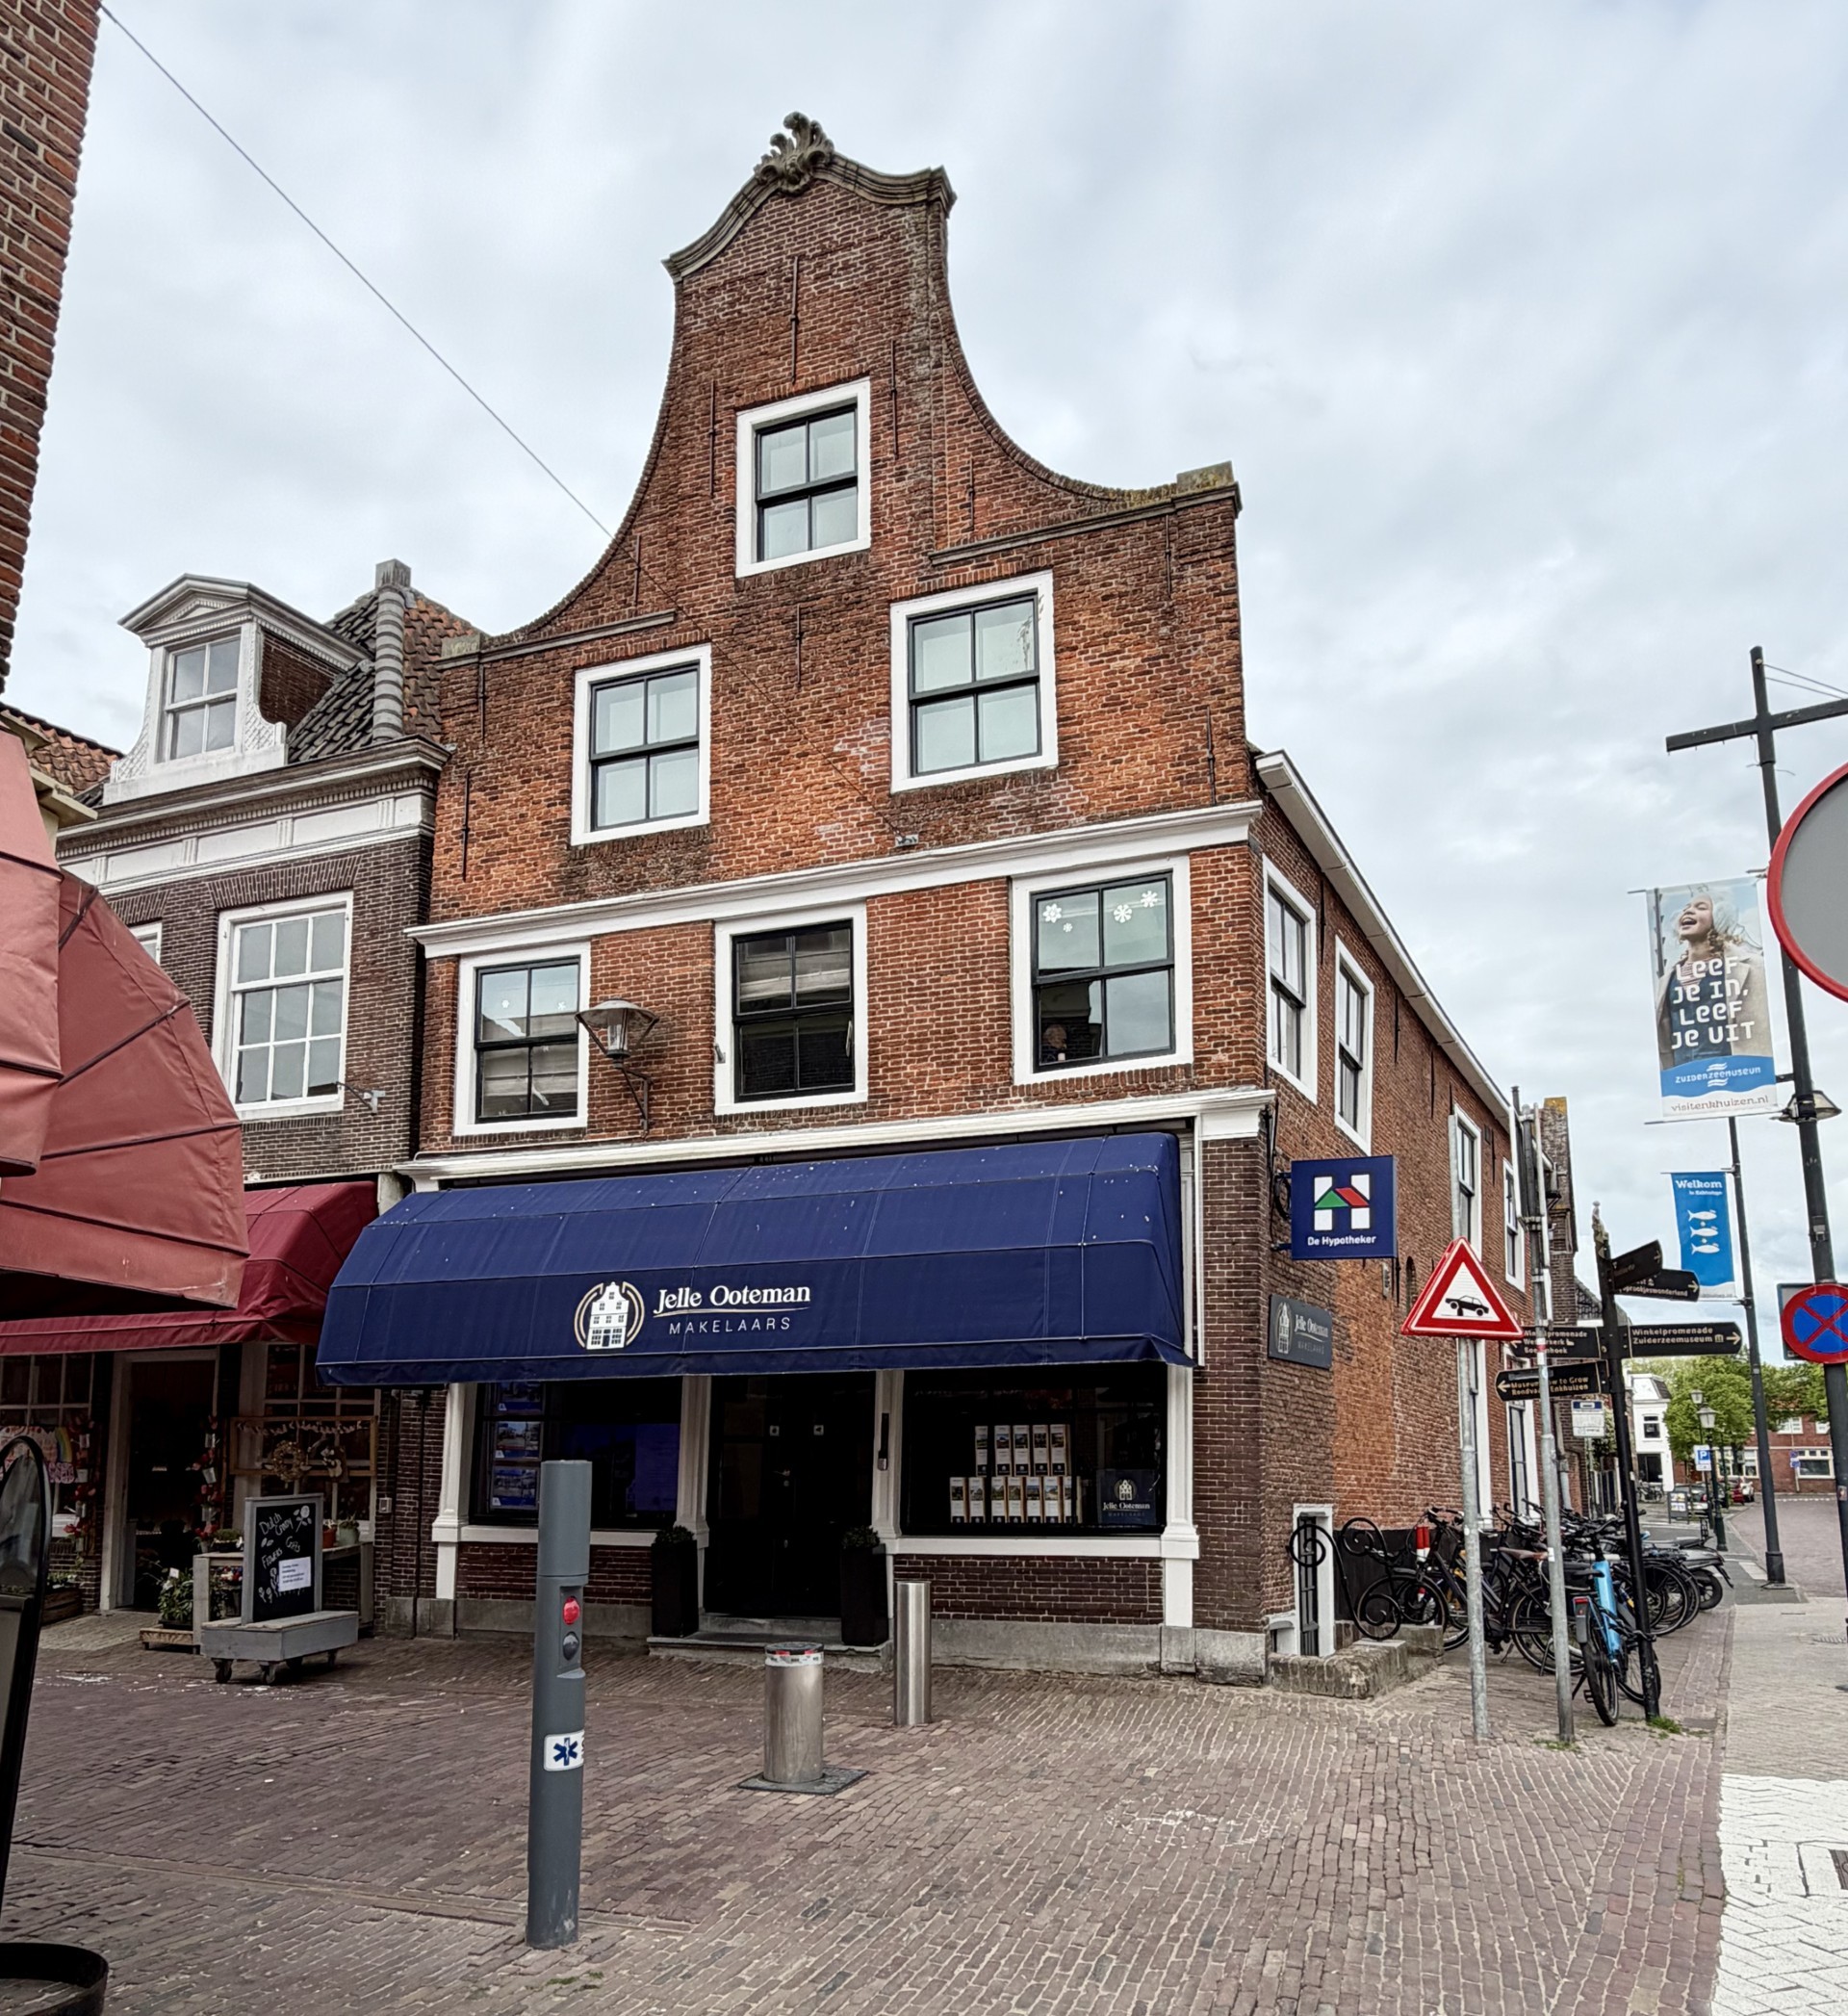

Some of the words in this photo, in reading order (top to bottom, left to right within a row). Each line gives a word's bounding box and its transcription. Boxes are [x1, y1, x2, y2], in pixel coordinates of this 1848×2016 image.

[1671, 1095, 1769, 1112] visitenkhuizen.nl
[1676, 1179, 1723, 1188] Welkom
[1307, 1236, 1320, 1246] De
[1322, 1235, 1376, 1247] Hypotheker
[654, 1286, 703, 1315] Jelle
[710, 1285, 810, 1305] Ooteman
[669, 1316, 791, 1335] MAKELAARS
[1632, 1327, 1713, 1336] Winkelpromenade
[1632, 1335, 1713, 1345] Zuiderzeemuseum
